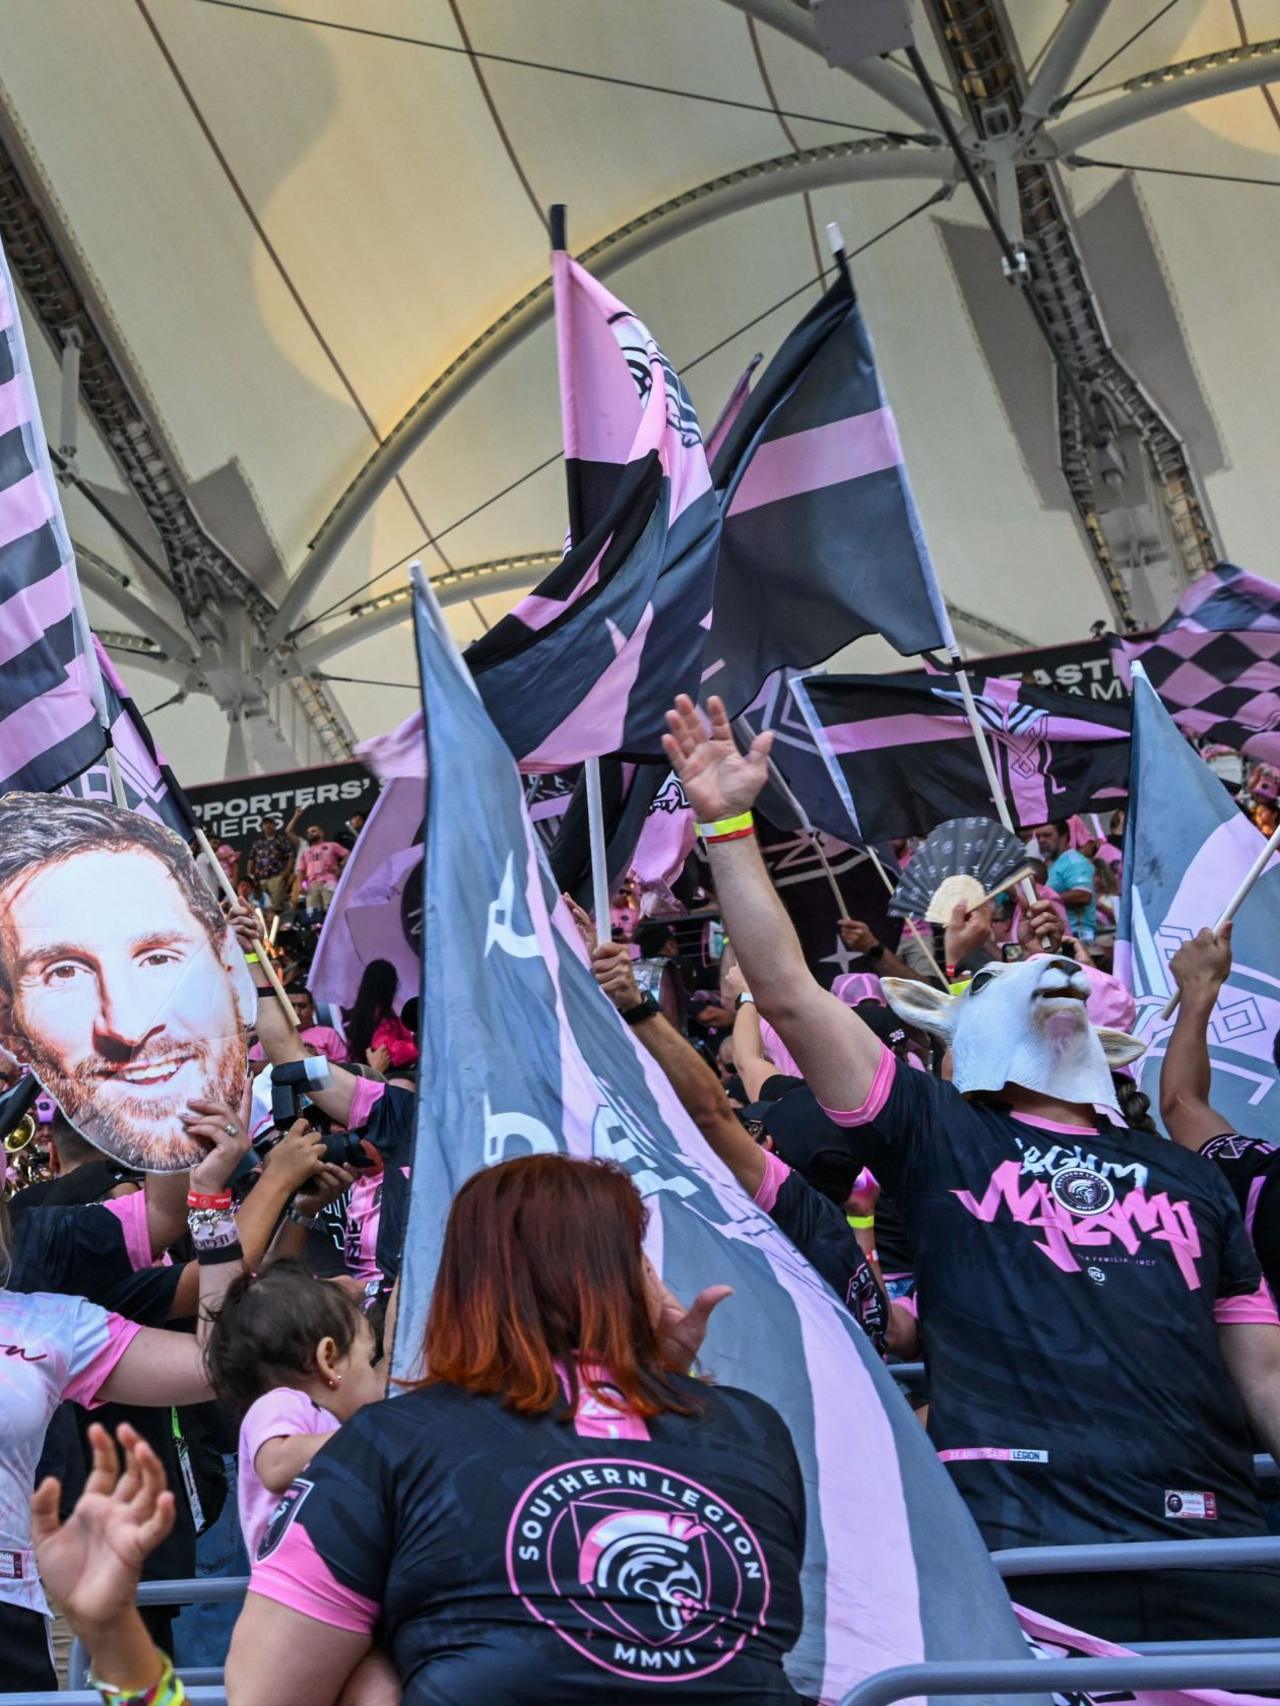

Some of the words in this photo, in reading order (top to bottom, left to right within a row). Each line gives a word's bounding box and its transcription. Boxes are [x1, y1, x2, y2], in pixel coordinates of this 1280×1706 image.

[1013, 1450, 1041, 1461] LEGION
[518, 1466, 648, 1562] SOUTHERN
[659, 1478, 763, 1581] LEGION
[613, 1642, 697, 1670] MMVI
